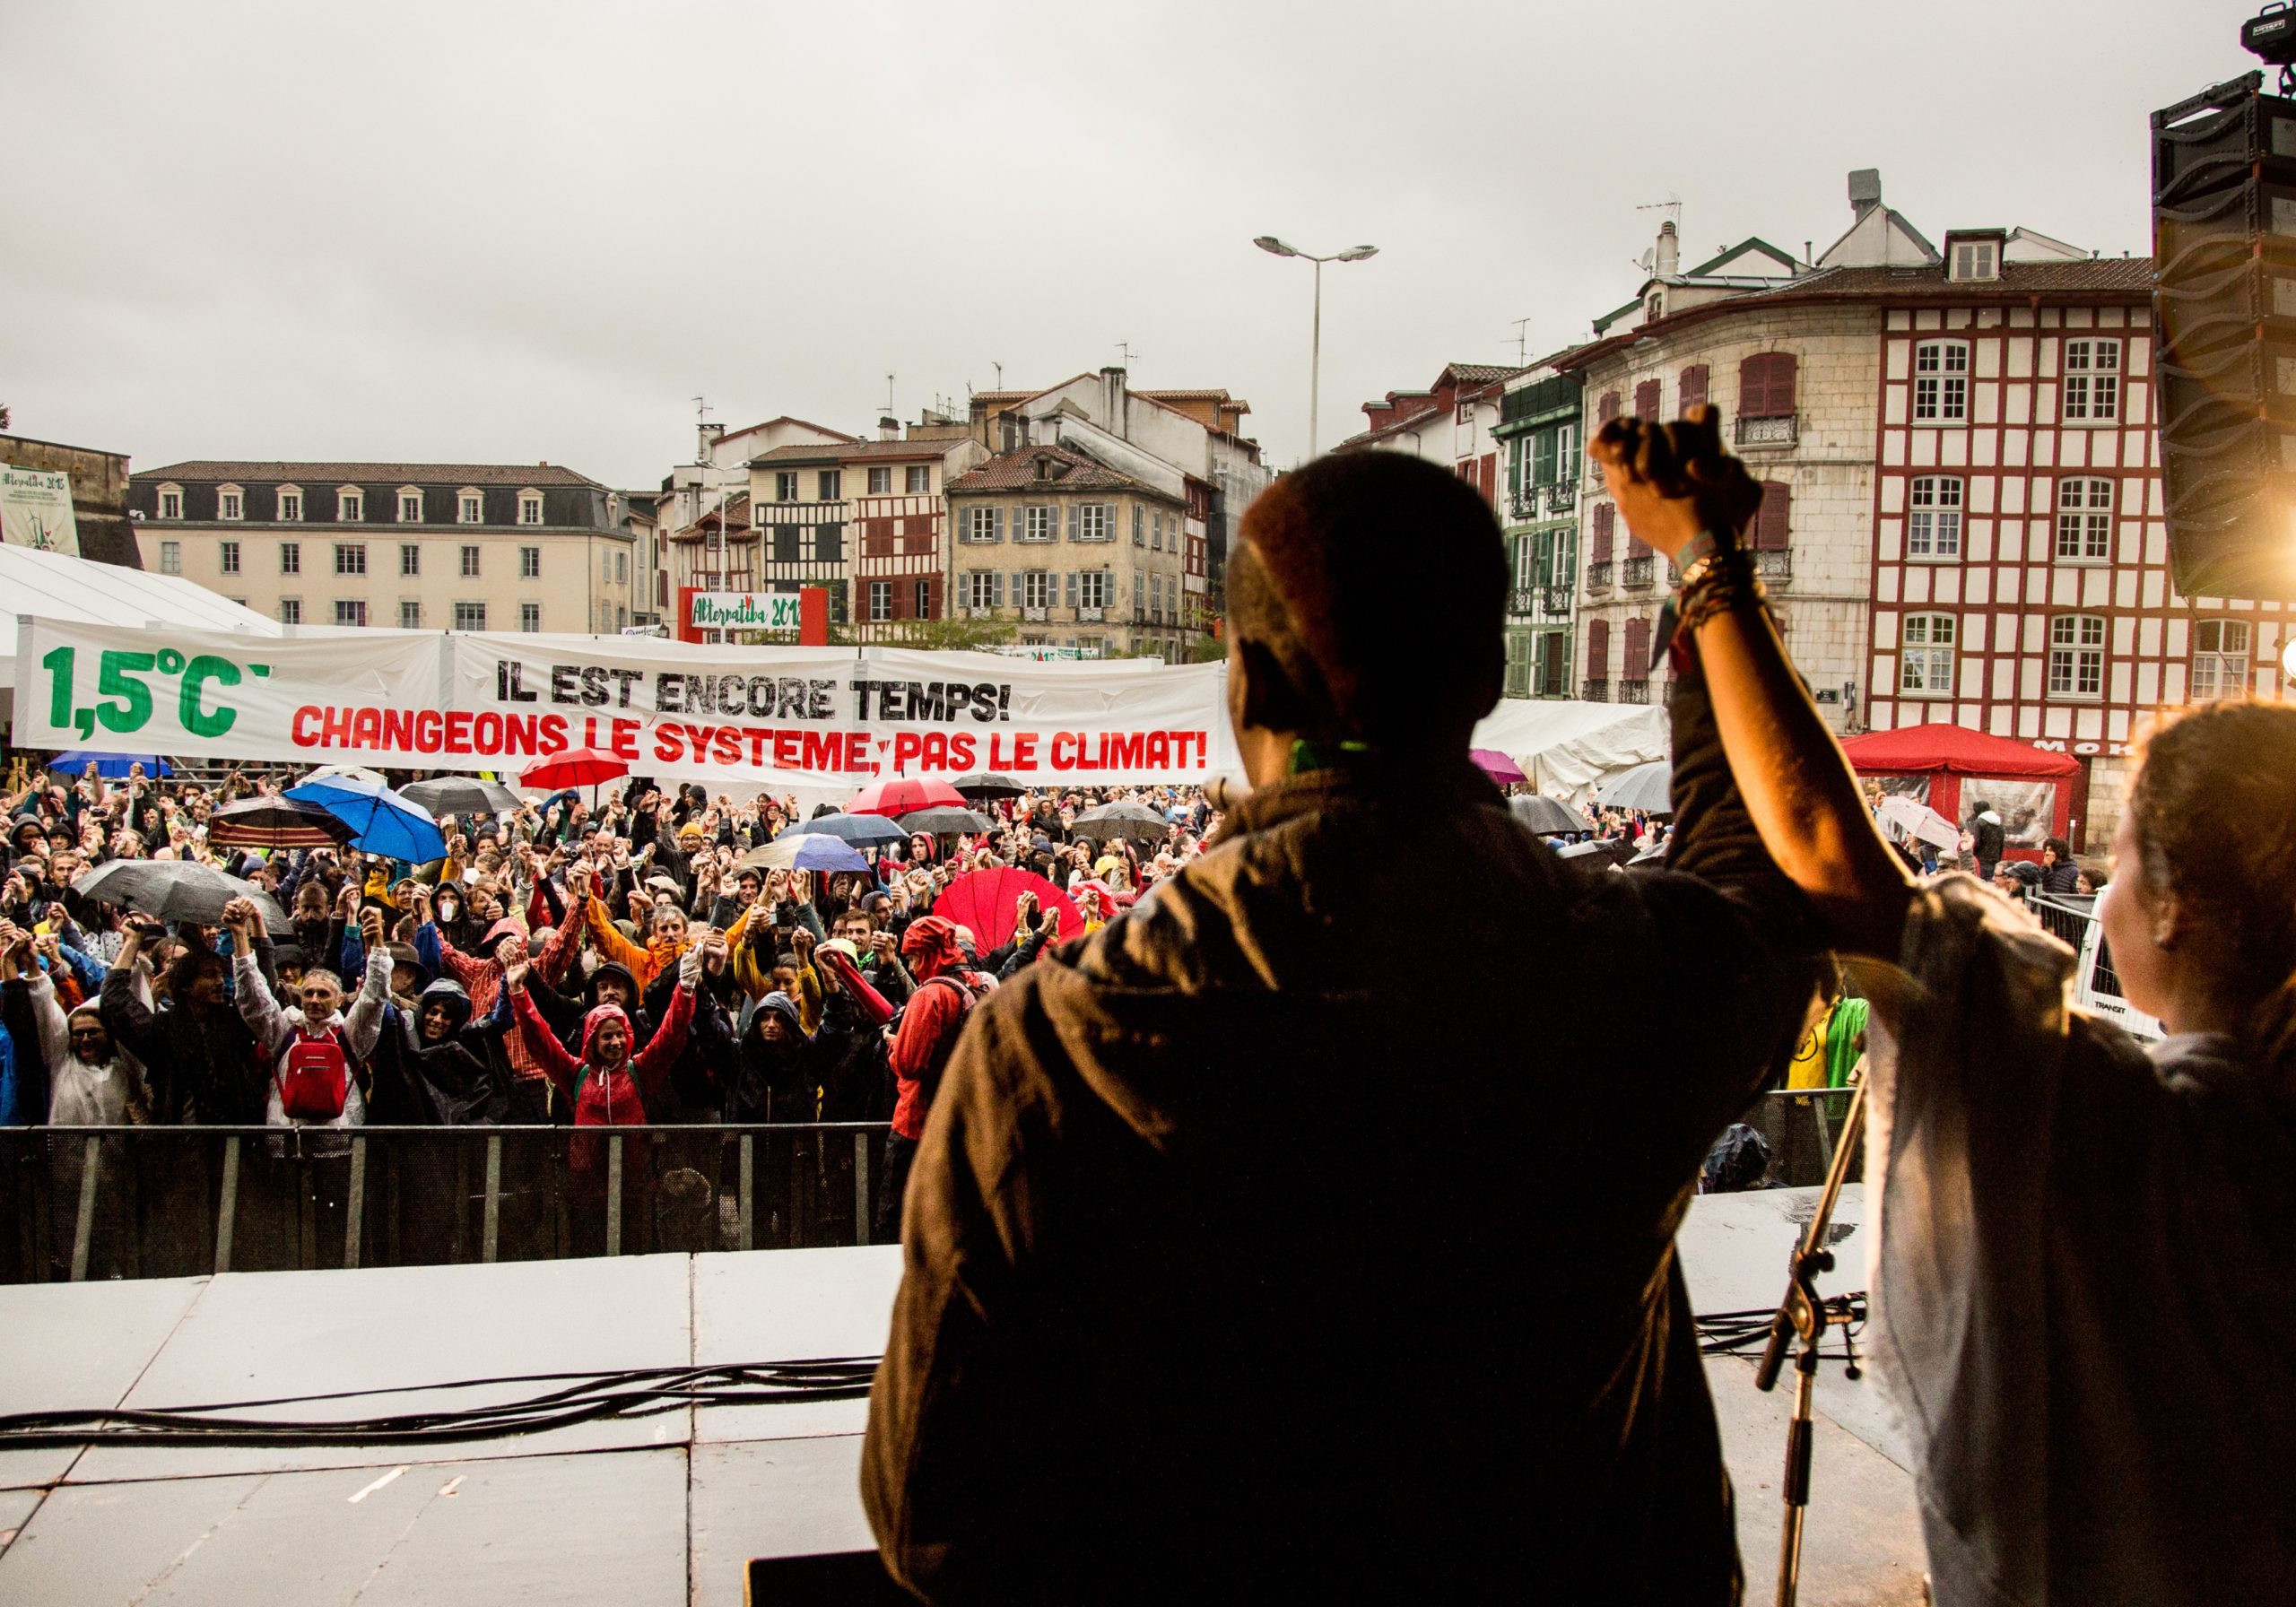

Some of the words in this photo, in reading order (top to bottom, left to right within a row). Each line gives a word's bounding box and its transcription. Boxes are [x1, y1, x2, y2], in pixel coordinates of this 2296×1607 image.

[693, 595, 768, 626] Alternatiba
[43, 647, 242, 741] 1,5°C
[498, 661, 537, 702] IL
[552, 665, 642, 708] EST
[656, 673, 837, 720] ENCORE
[849, 680, 1011, 722] TEMPS!
[291, 705, 569, 755] CHANGEONS
[585, 717, 640, 760] LE
[654, 722, 880, 777] SYSTEME,
[894, 732, 976, 772] PAS
[989, 733, 1039, 771] LE
[1051, 731, 1207, 771] CLIMAT!
[2094, 1001, 2126, 1014] TRANSIT
